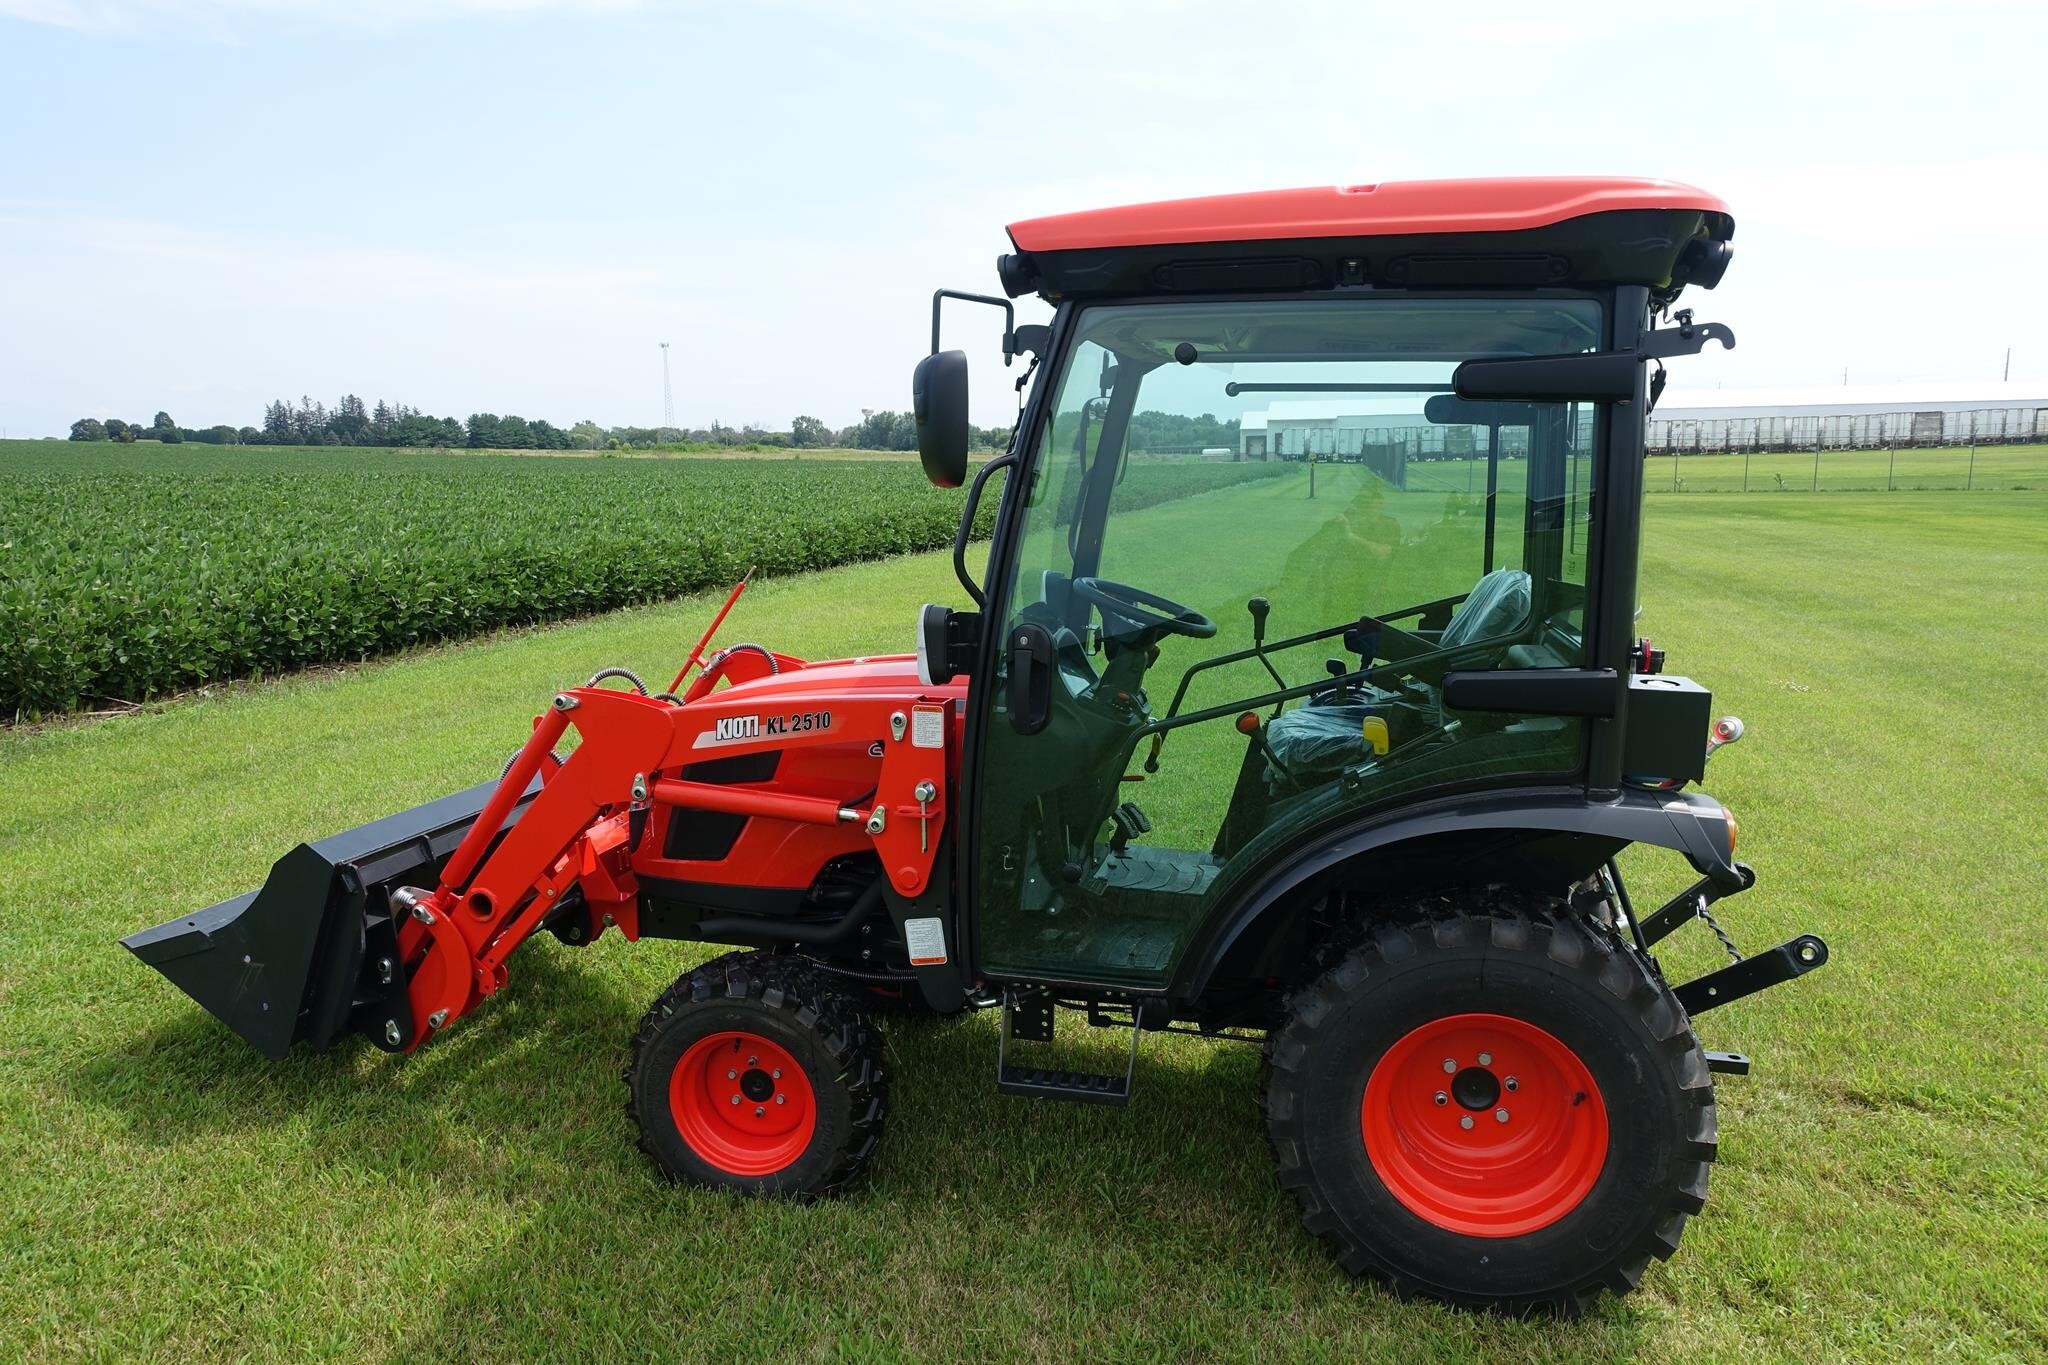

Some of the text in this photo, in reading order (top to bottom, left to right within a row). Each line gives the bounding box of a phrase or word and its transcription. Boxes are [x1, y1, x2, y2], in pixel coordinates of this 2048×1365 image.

[716, 711, 832, 741] KIOTI KL 2510
